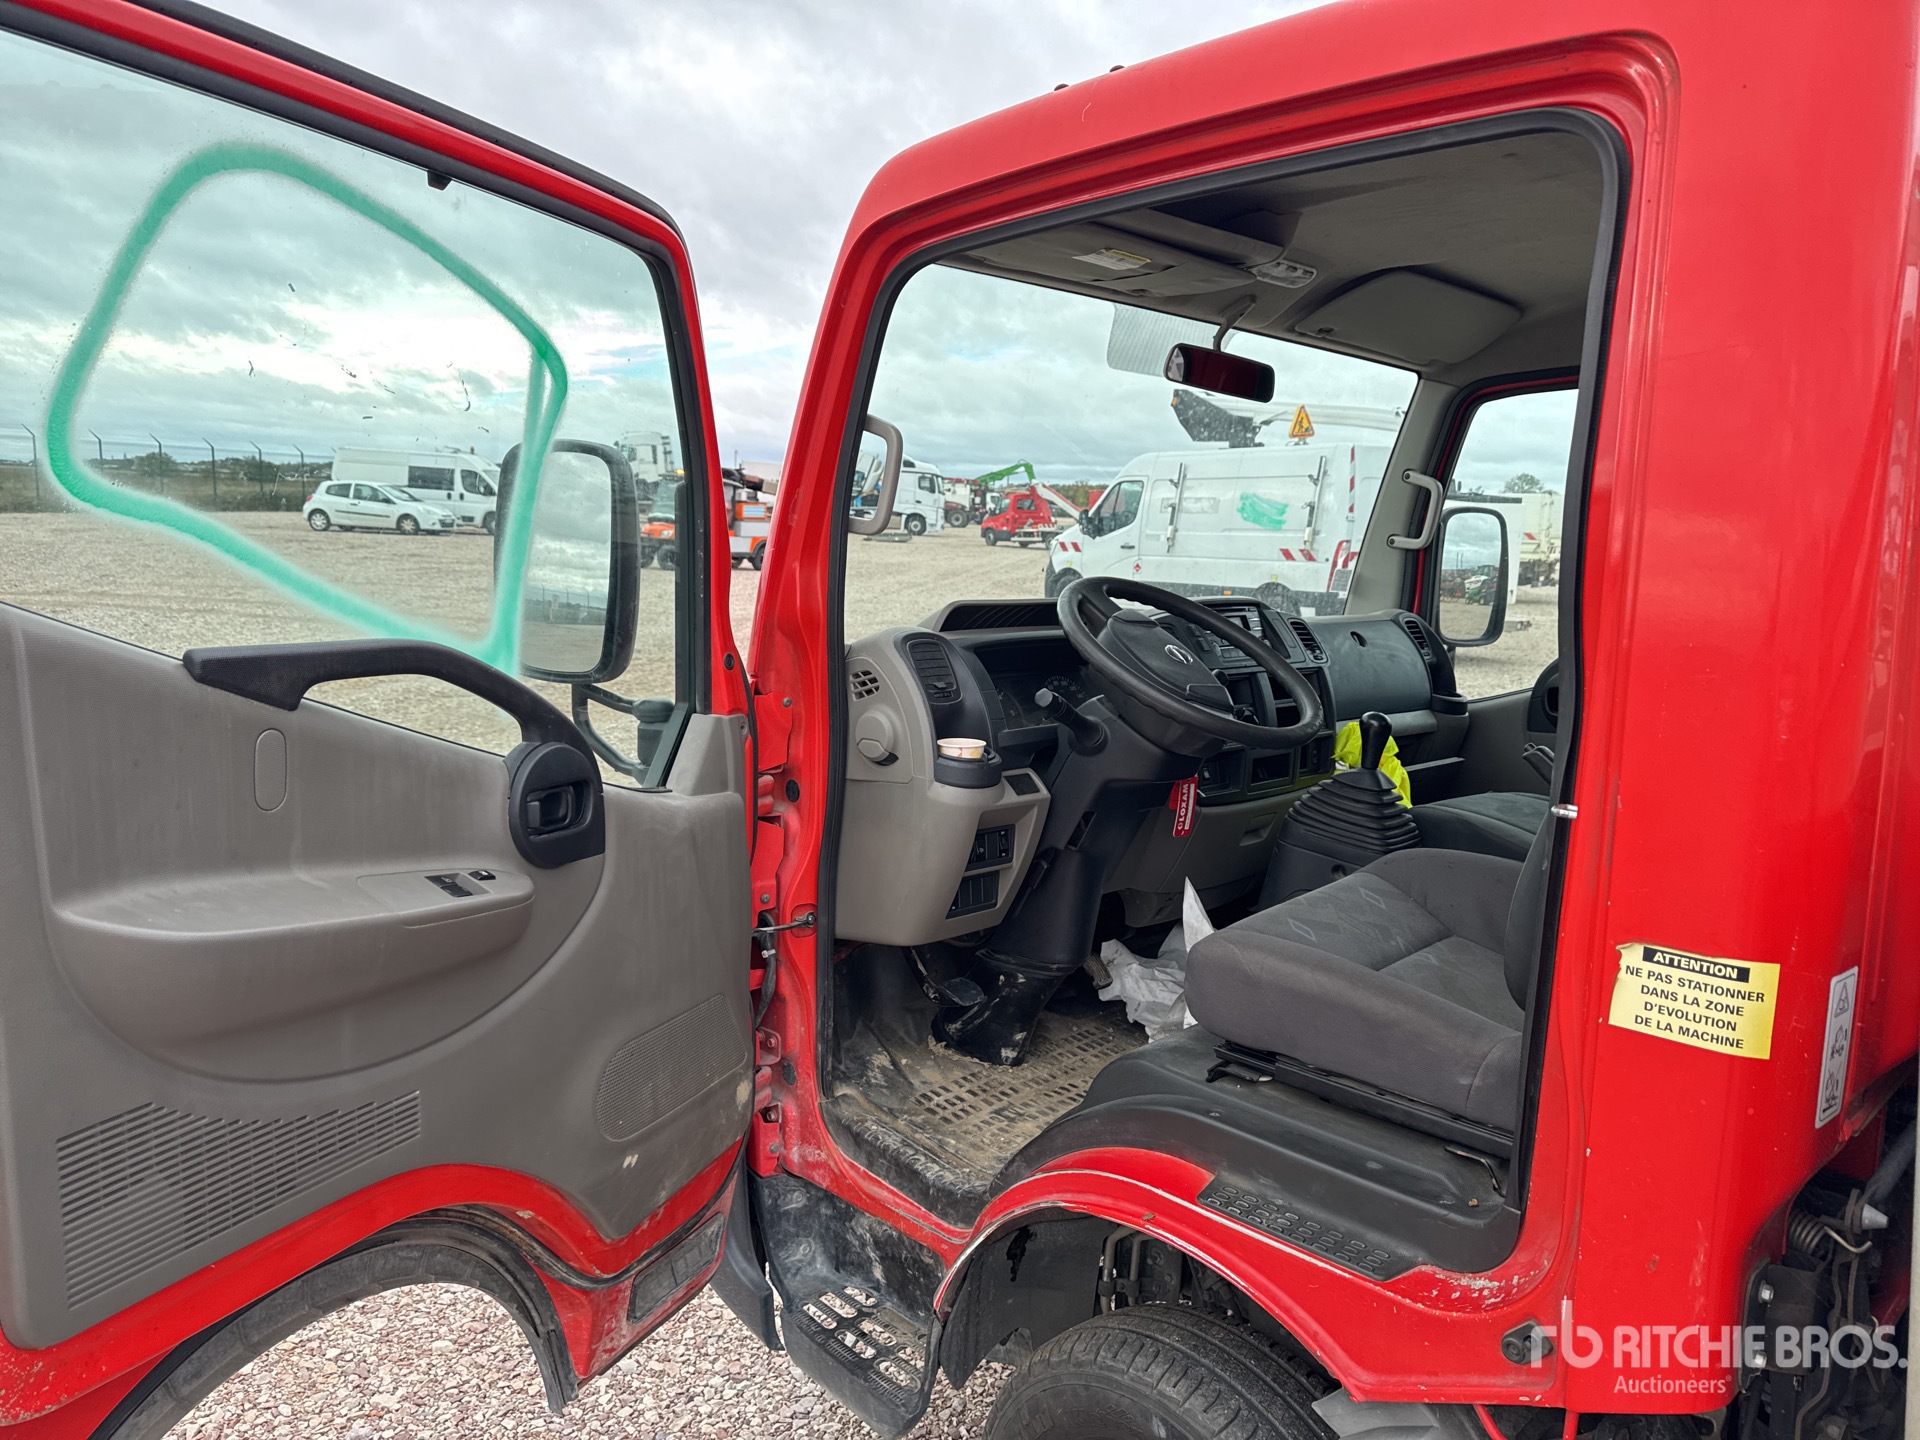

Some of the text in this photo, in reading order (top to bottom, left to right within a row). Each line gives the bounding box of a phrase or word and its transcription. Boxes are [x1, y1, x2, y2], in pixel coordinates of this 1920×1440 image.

[1653, 952, 1738, 979] ATTENTION
[1625, 964, 1765, 1003] NE PAS STATIONNER
[1640, 984, 1744, 1017] DANS LA ZONE
[1644, 1001, 1737, 1032] D'EVOLUTION
[1634, 1014, 1744, 1049] DE LA MACHINE
